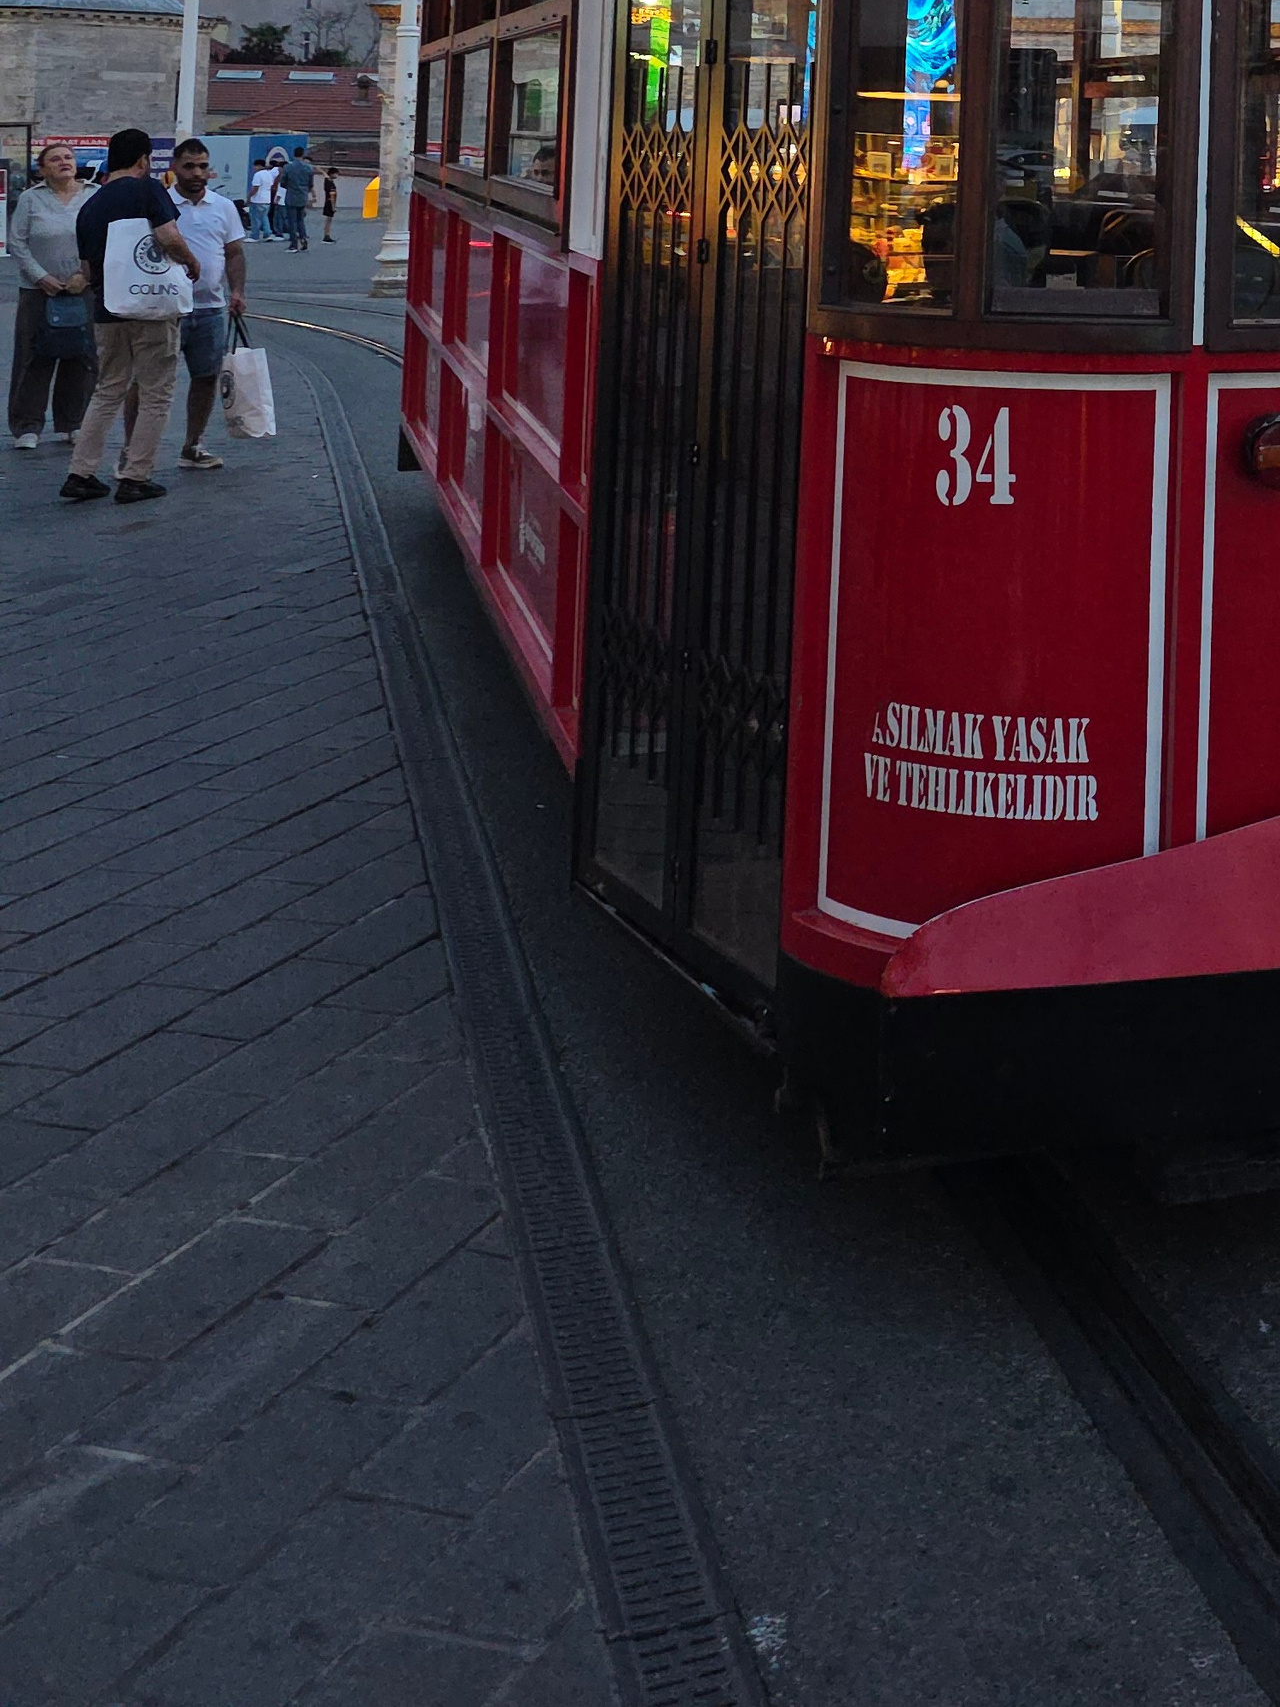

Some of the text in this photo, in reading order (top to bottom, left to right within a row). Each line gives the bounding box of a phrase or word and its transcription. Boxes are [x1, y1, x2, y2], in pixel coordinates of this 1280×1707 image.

[128, 282, 180, 296] COLIN'S
[934, 404, 1017, 507] 34
[991, 714, 1091, 764] YASAK
[863, 752, 1099, 822] VE TEHLIKELIDIR
